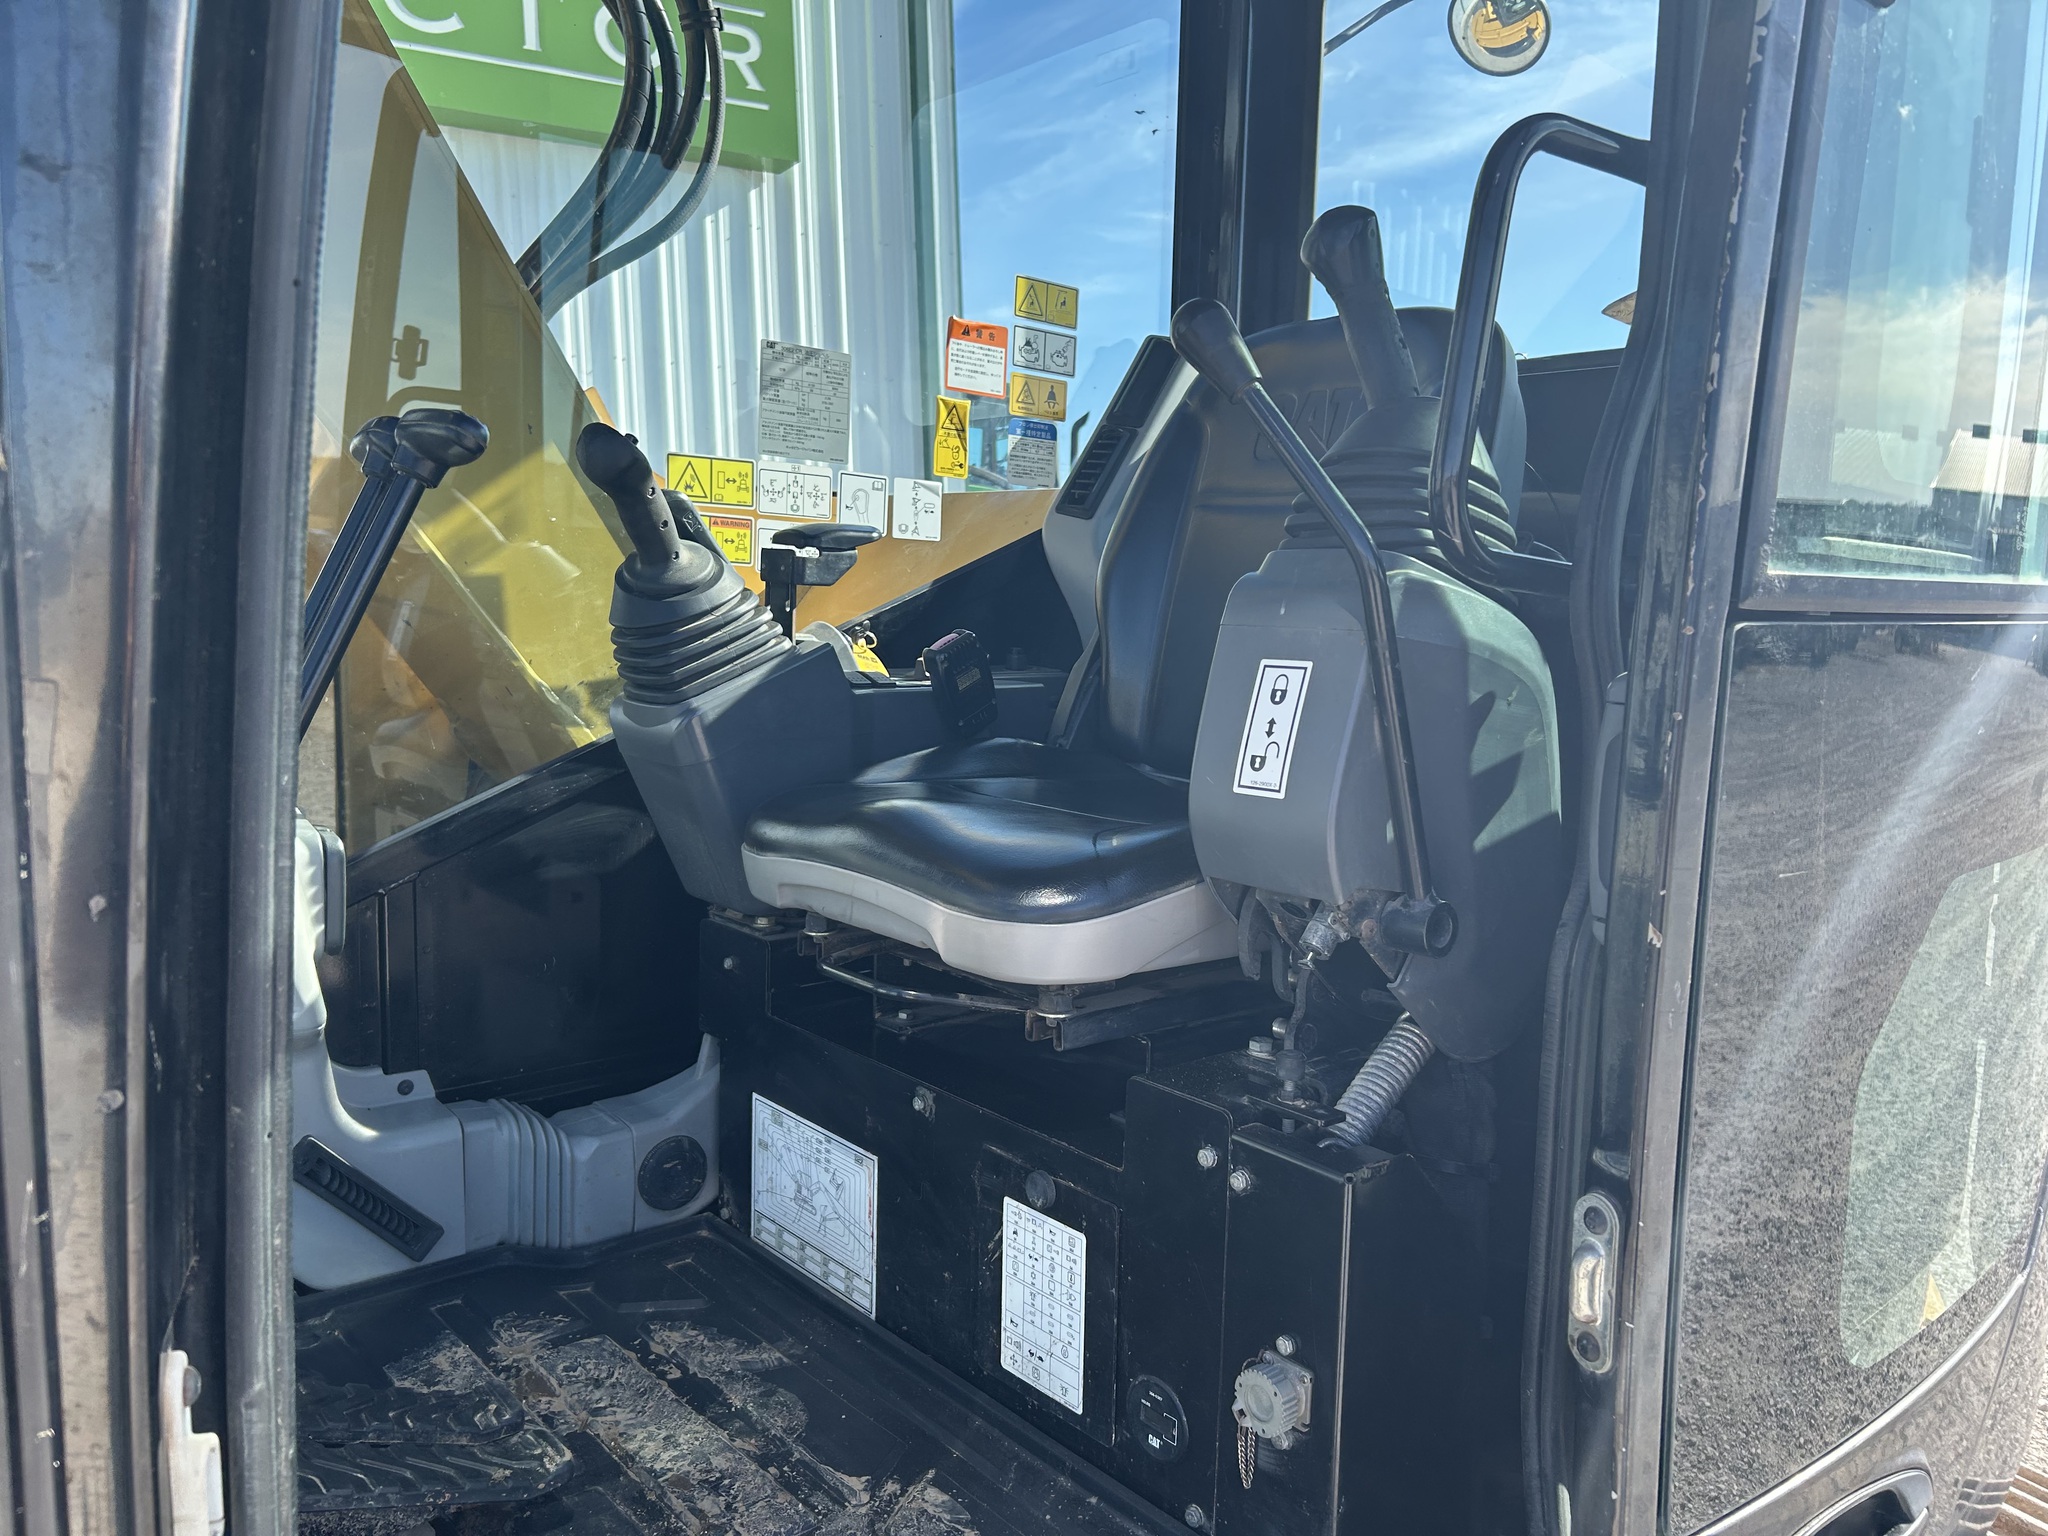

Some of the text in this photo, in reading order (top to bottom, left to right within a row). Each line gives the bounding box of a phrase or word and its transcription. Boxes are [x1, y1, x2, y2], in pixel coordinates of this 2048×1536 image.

[766, 341, 777, 349] CAT
[719, 518, 750, 529] WARNING
[1148, 1433, 1161, 1449] CAT
